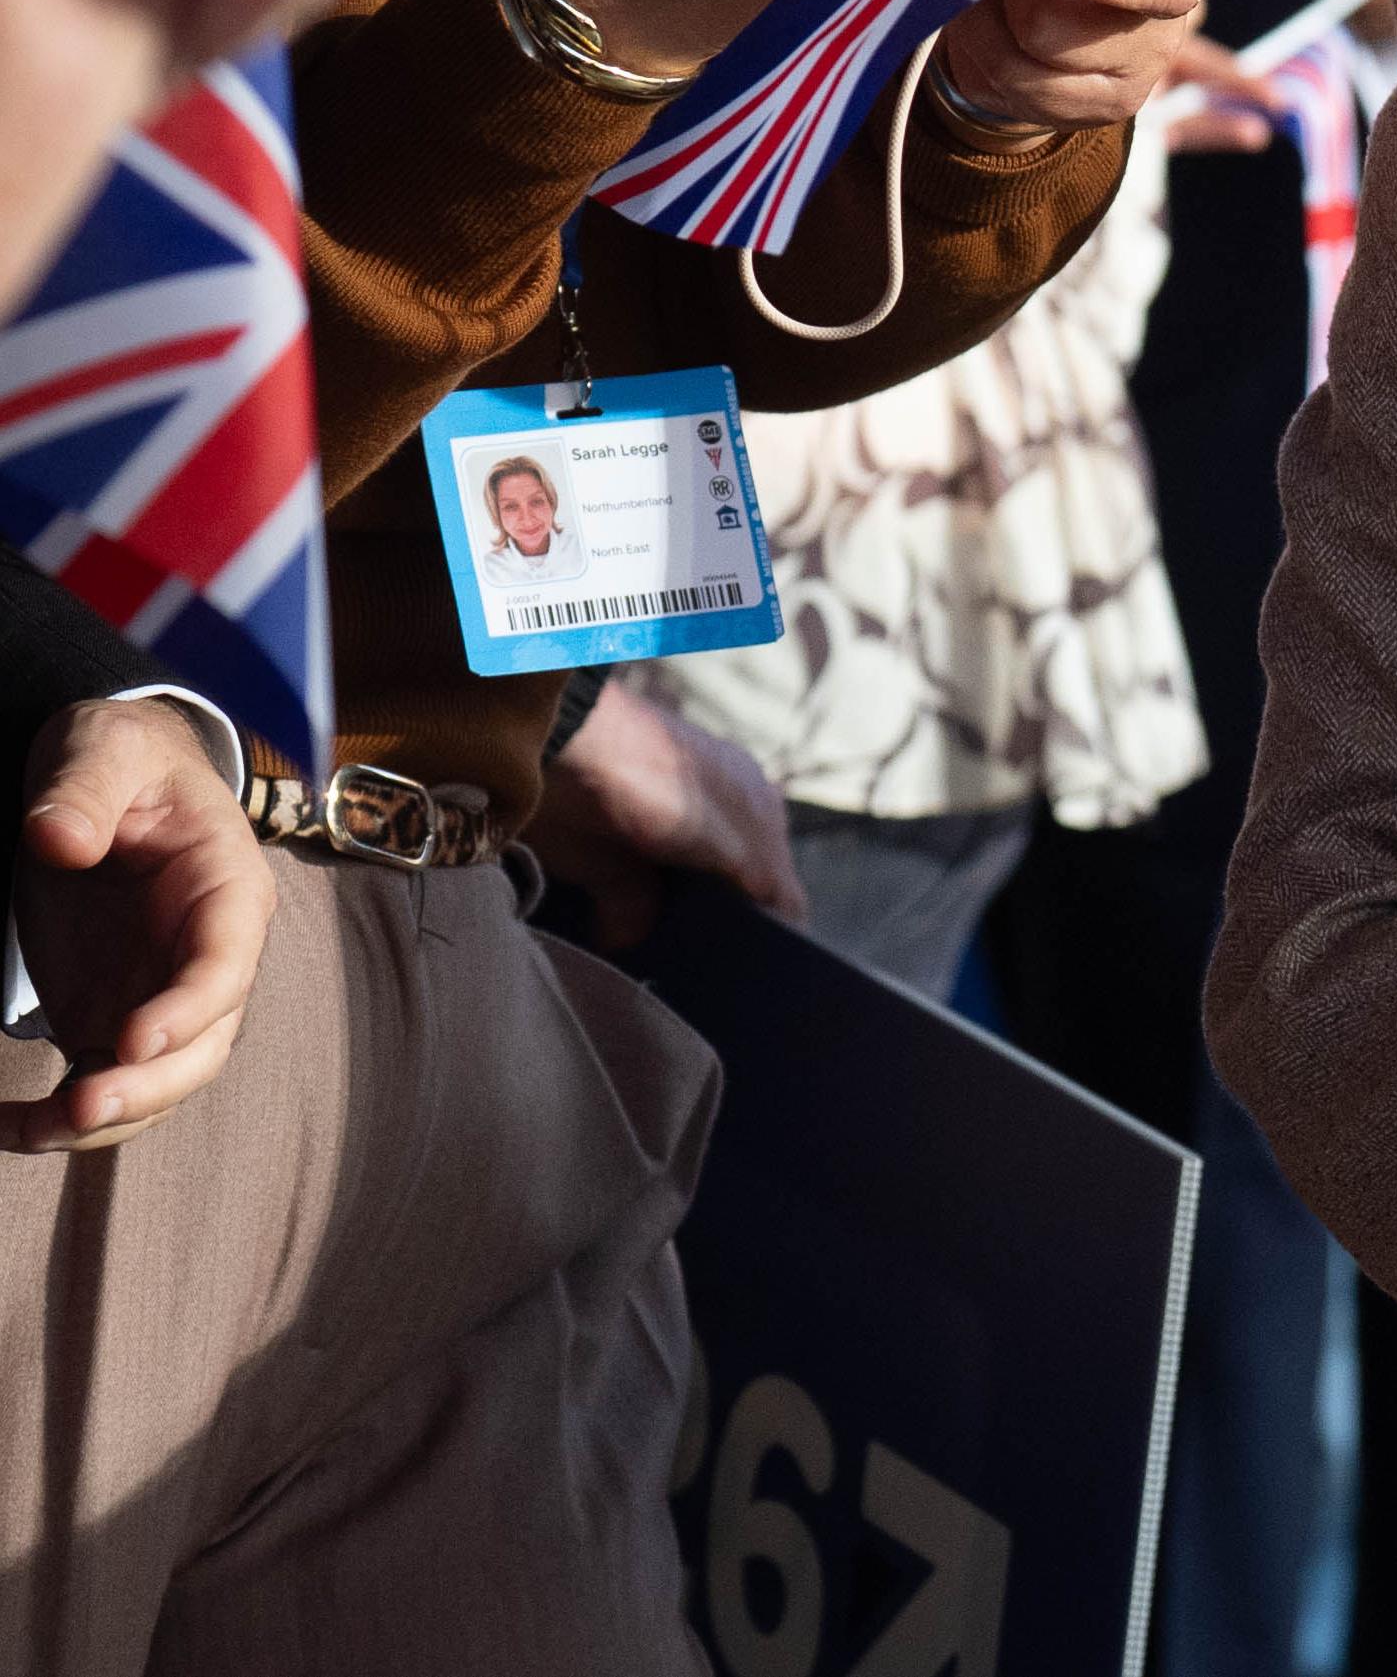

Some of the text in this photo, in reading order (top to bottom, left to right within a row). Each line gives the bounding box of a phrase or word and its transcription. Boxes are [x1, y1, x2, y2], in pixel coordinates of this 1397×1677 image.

[571, 442, 669, 461] Sarah Legge
[712, 480, 731, 497] RR
[582, 495, 673, 514] Northumberland
[591, 543, 651, 557] North East
